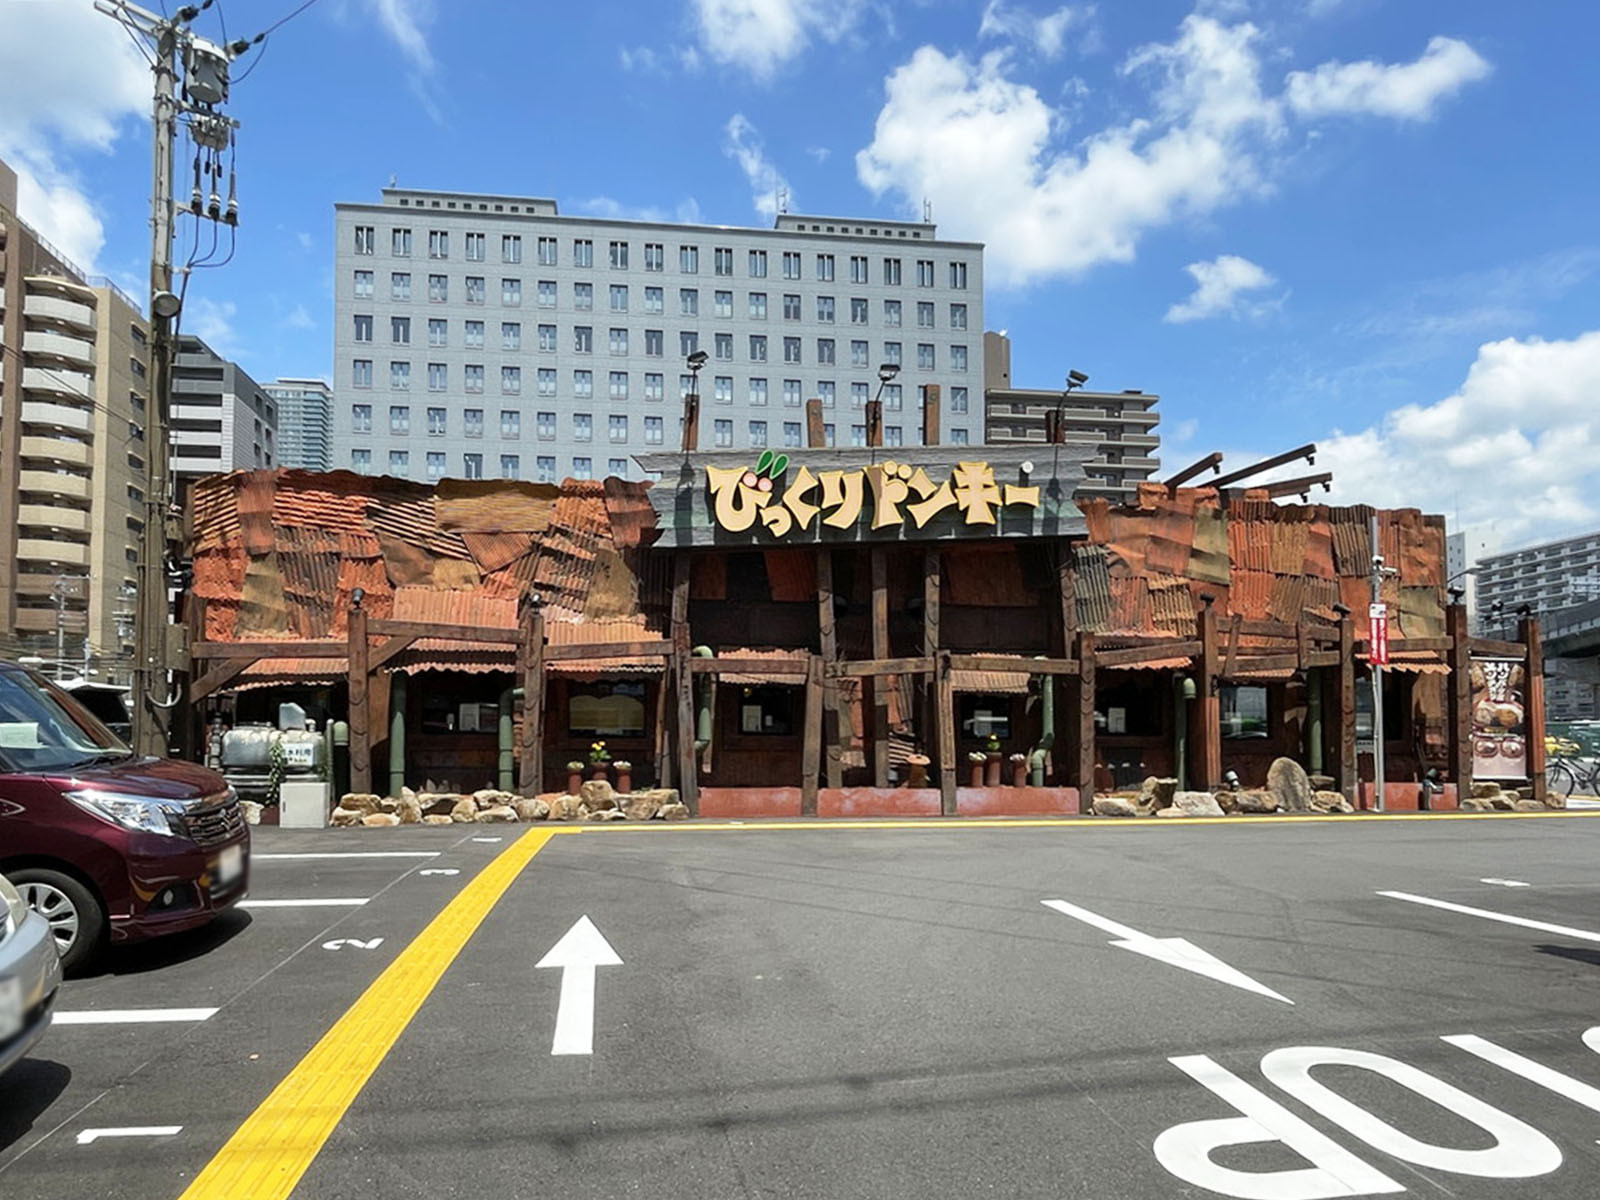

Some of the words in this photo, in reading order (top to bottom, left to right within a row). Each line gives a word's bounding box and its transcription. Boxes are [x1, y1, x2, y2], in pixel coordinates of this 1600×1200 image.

[705, 460, 1040, 537] びっくりドンキー
[1153, 1026, 1600, 1200] OP
